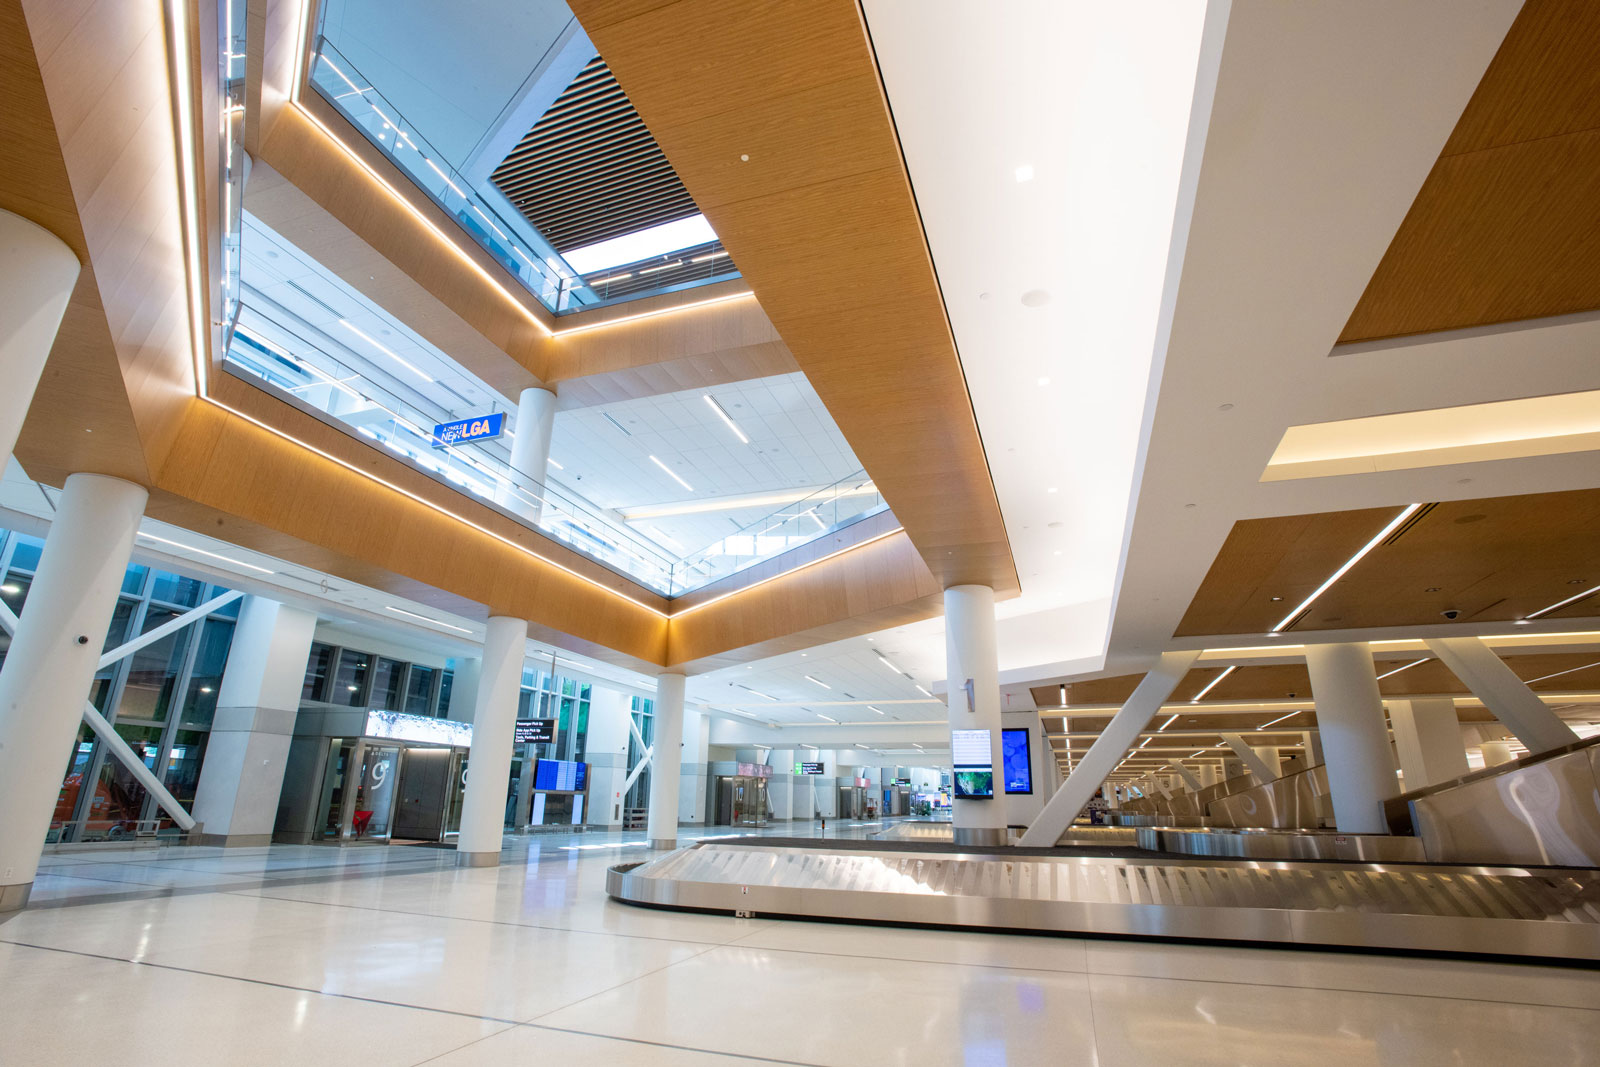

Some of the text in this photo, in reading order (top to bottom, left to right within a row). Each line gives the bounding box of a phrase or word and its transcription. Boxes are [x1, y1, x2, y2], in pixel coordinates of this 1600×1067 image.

[441, 429, 463, 441] NEW
[461, 419, 491, 438] LGA
[964, 679, 975, 713] 1
[371, 762, 386, 790] 9
[1163, 780, 1170, 788] 5
